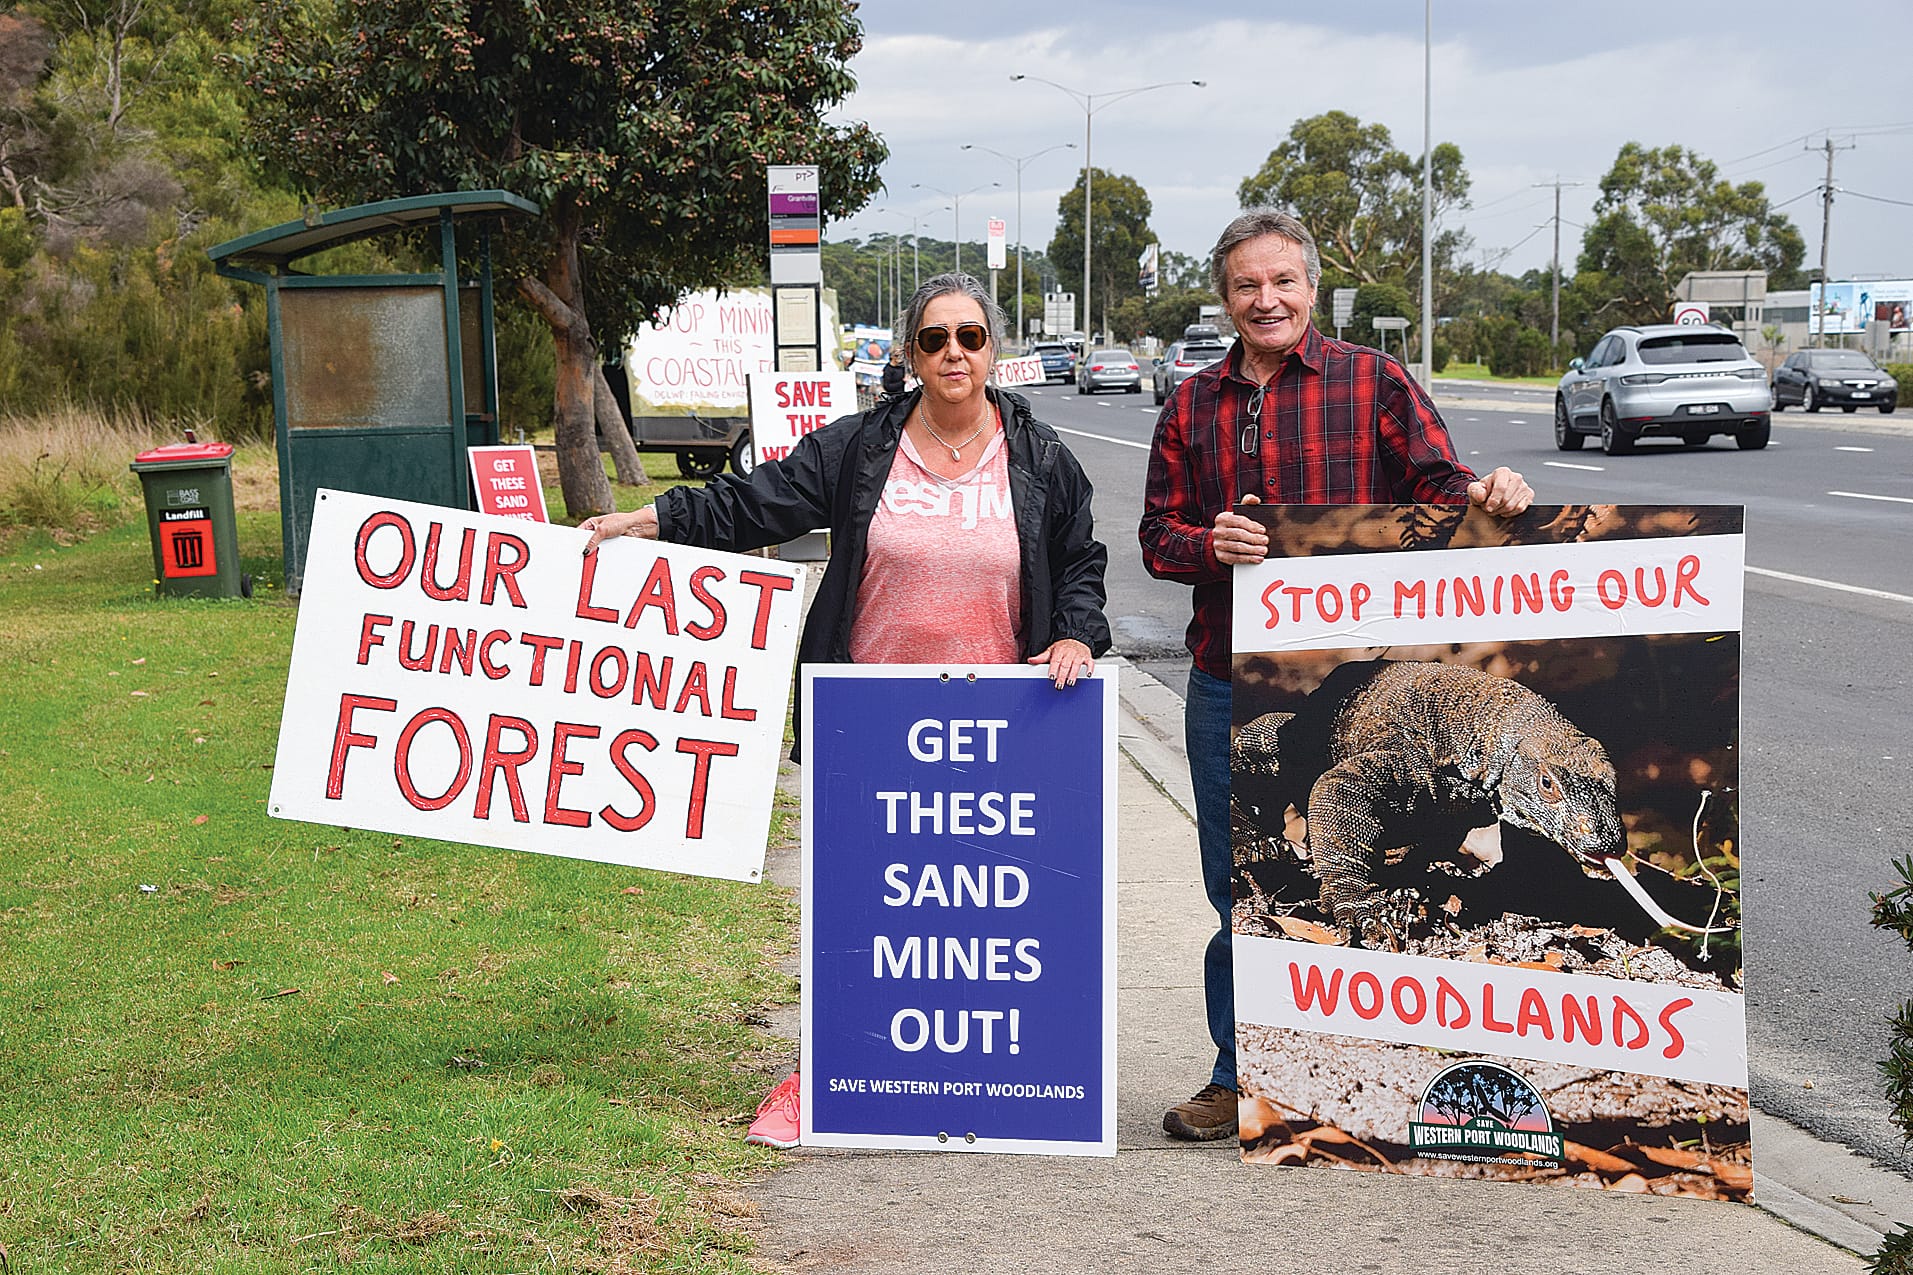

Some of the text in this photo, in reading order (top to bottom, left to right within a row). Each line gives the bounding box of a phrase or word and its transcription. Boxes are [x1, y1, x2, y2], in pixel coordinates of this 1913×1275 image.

[715, 336, 742, 354] THIS
[647, 357, 748, 387] COASTAL
[999, 360, 1041, 382] FOREST
[775, 381, 832, 408] SAVE
[785, 414, 827, 437] THE
[493, 459, 515, 472] GET
[179, 489, 199, 497] BASS
[490, 477, 526, 491] THESE
[165, 510, 204, 520] Landfill
[495, 495, 528, 509] SAND
[355, 511, 793, 649] OUR LAST
[1260, 555, 1710, 629] STOP MINING OUR
[357, 613, 757, 721] FUNCTIONAL
[907, 719, 1008, 763] GET
[326, 693, 739, 839] FOREST
[876, 791, 1036, 836] THESE
[883, 863, 1030, 908] SAND
[873, 935, 1042, 982] MINES
[1289, 961, 1694, 1059] WOODLANDS
[890, 1008, 1020, 1055] OUT!
[829, 1078, 1085, 1100] SAVE WESTERN PORT WOODLANDS
[1476, 1119, 1494, 1129] SAVE
[1413, 1125, 1560, 1157] WESTERN PORT WOODLANDS
[1417, 1150, 1559, 1170] www.savewesternportwoodlands.org
